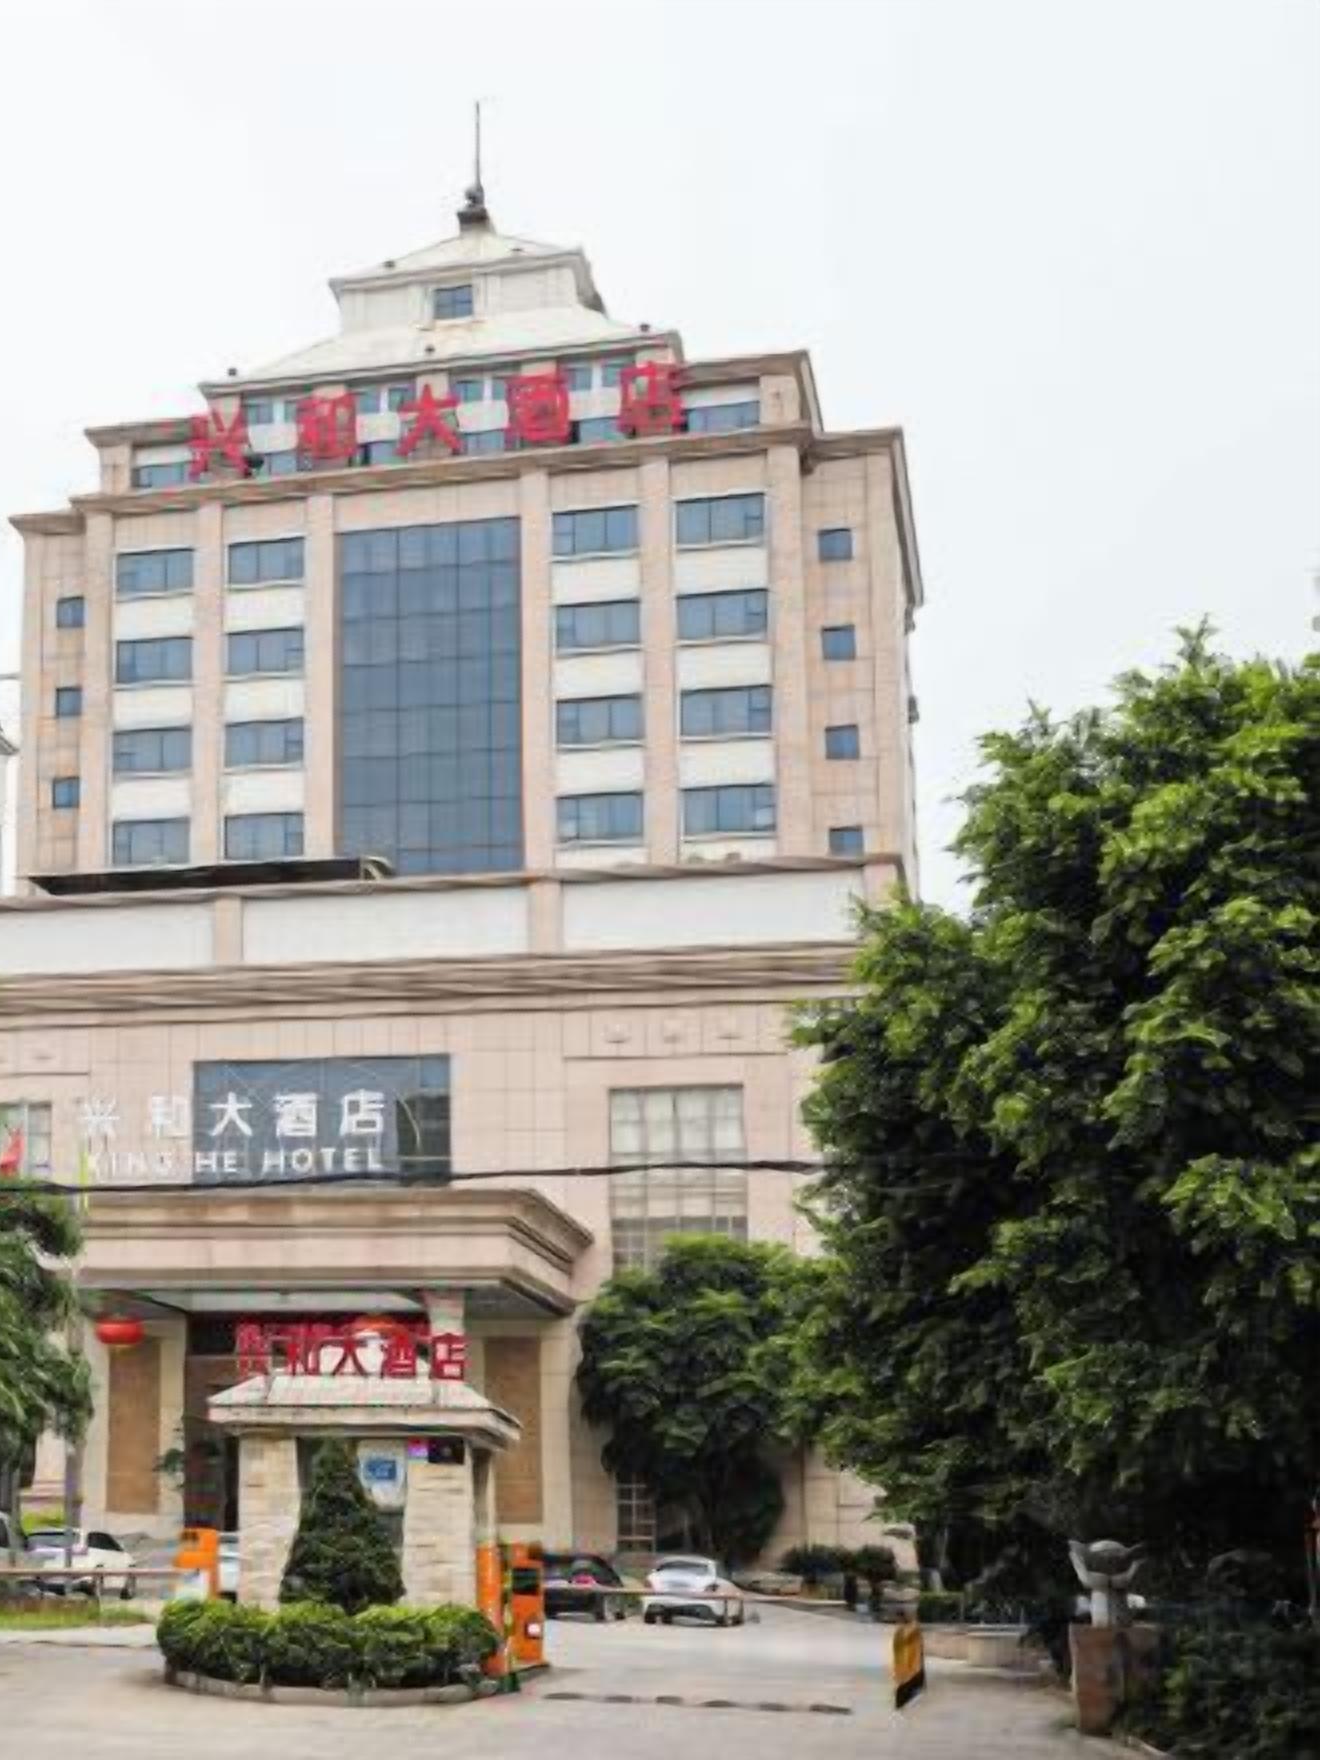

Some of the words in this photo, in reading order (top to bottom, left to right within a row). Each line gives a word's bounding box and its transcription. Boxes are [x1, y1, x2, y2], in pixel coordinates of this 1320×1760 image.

[80, 1089, 386, 1139] 兴和大酒店
[195, 1150, 239, 1173] HE
[262, 1147, 385, 1175] HOTEL
